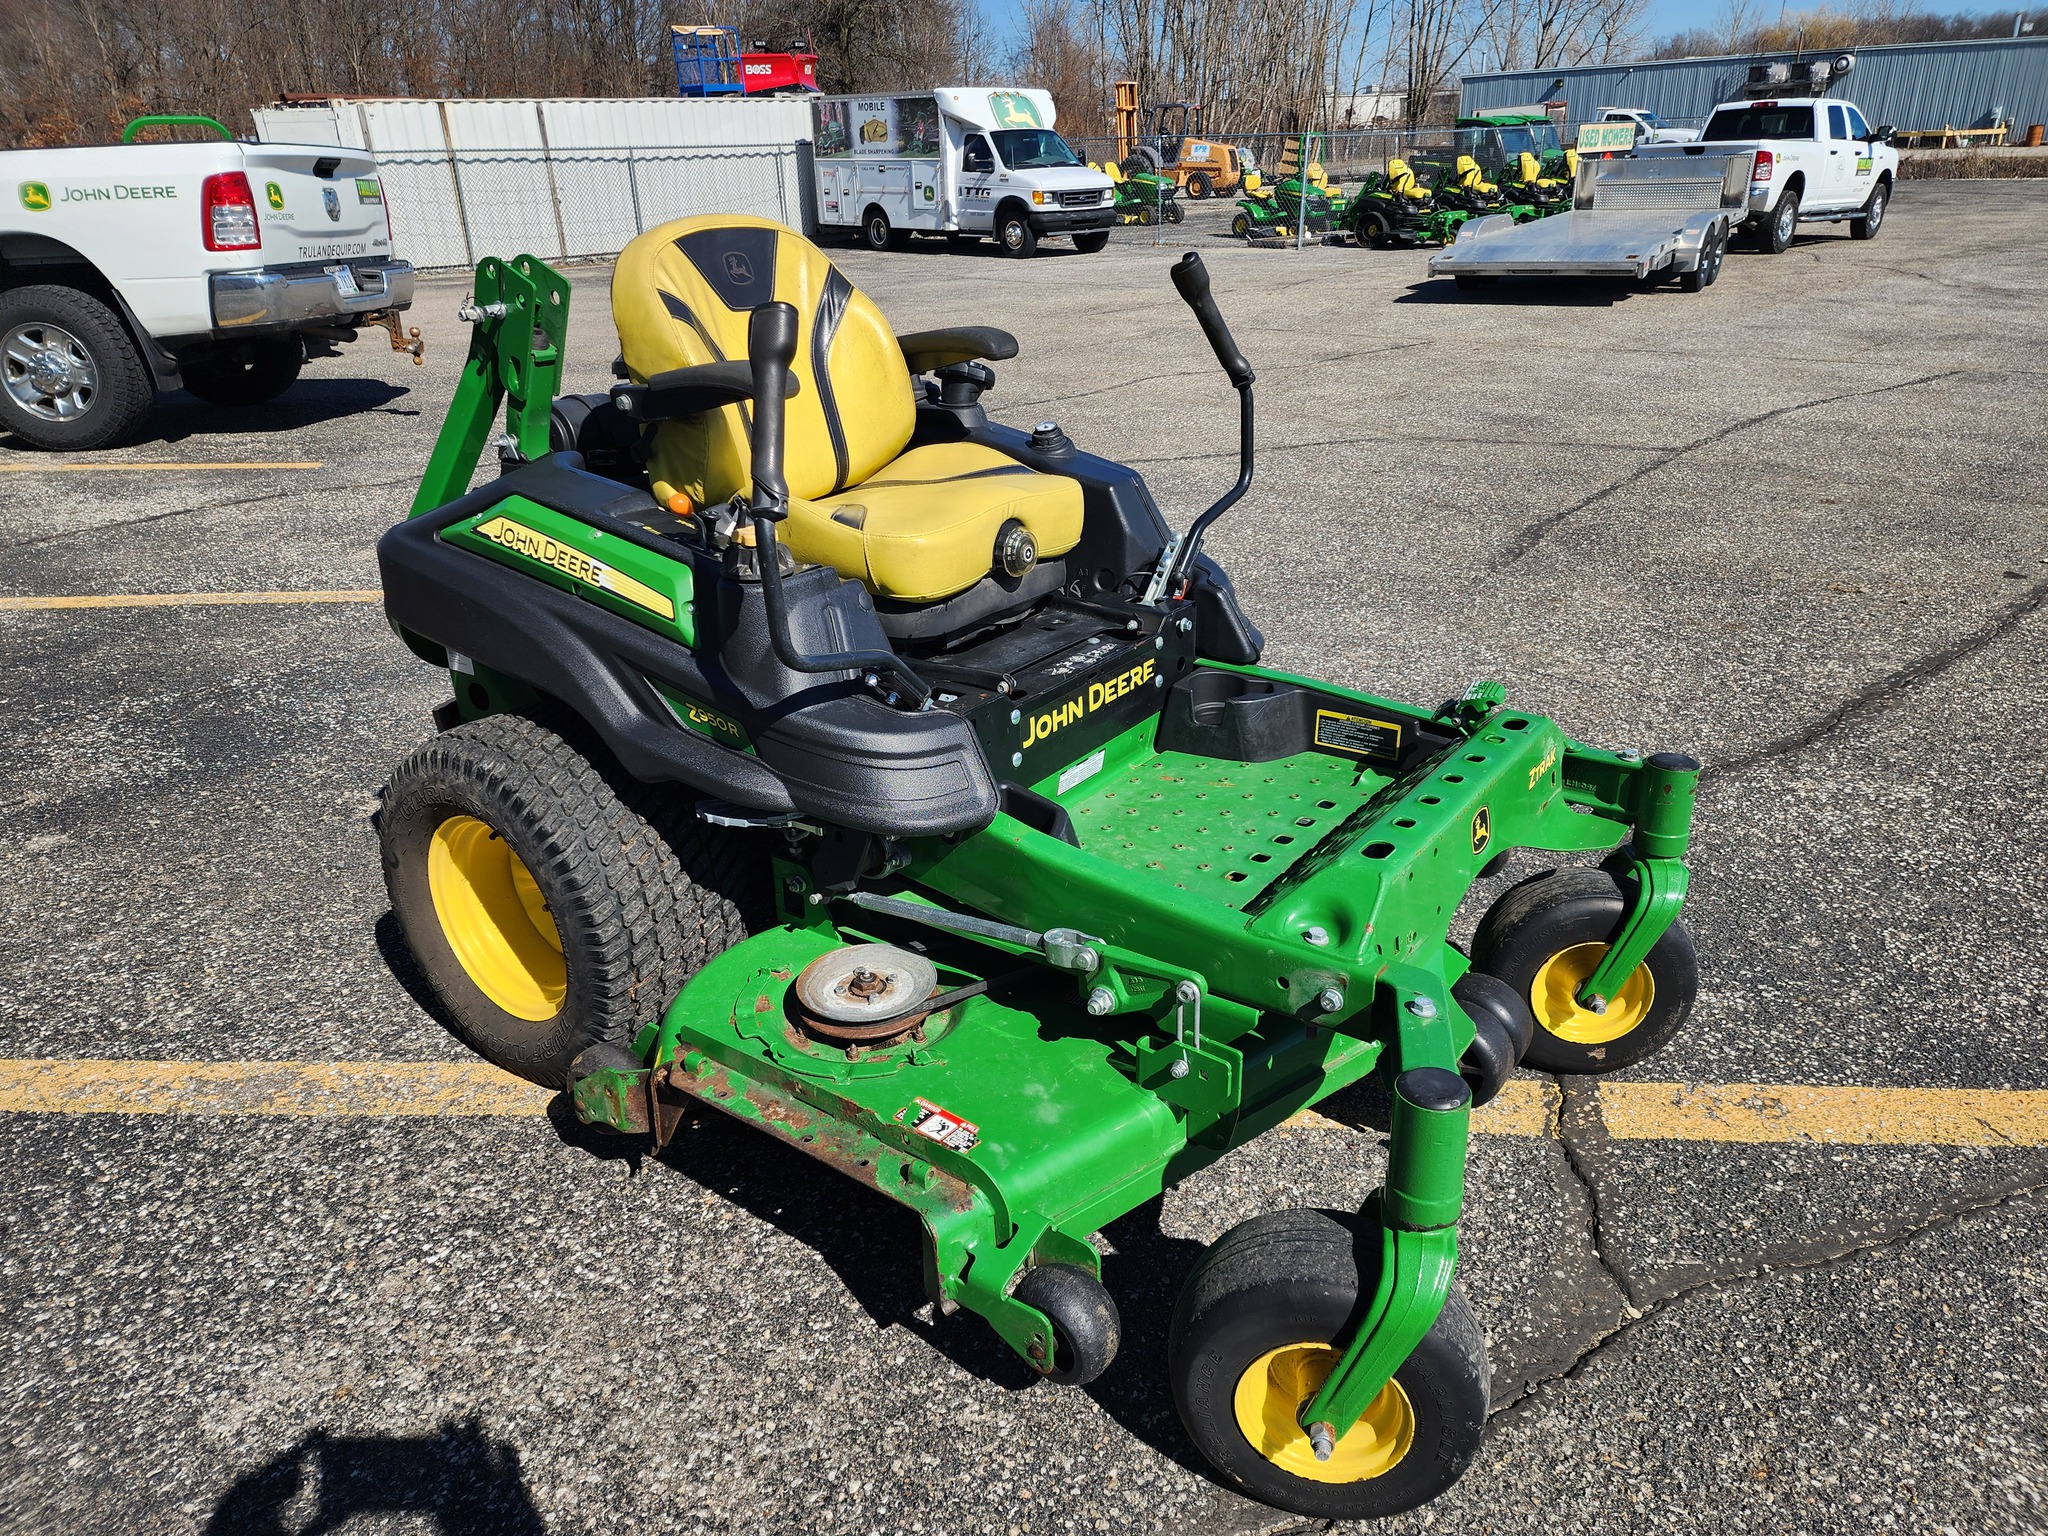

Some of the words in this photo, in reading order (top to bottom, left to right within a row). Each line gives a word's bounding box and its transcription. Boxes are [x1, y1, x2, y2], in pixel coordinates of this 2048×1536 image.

[745, 64, 772, 75] BOSS
[858, 102, 885, 111] MOBILE
[1578, 128, 1600, 148] USED
[1601, 127, 1634, 147] MOWERS
[60, 186, 111, 202] JOHN
[113, 185, 177, 200] DEERE
[964, 187, 992, 198] TTG
[264, 212, 279, 221] JOHN
[278, 212, 295, 221] DEERE
[298, 242, 367, 259] TRULANDEQUIP.COM
[495, 522, 541, 556] JOHN
[543, 540, 602, 584] DEERE
[1022, 696, 1084, 749] JOHN
[1088, 658, 1155, 713] DEERE
[1528, 747, 1556, 791] ZTRAK
[1195, 1349, 1236, 1462] RELIANCE
[1406, 1354, 1457, 1467] CARLISLE
